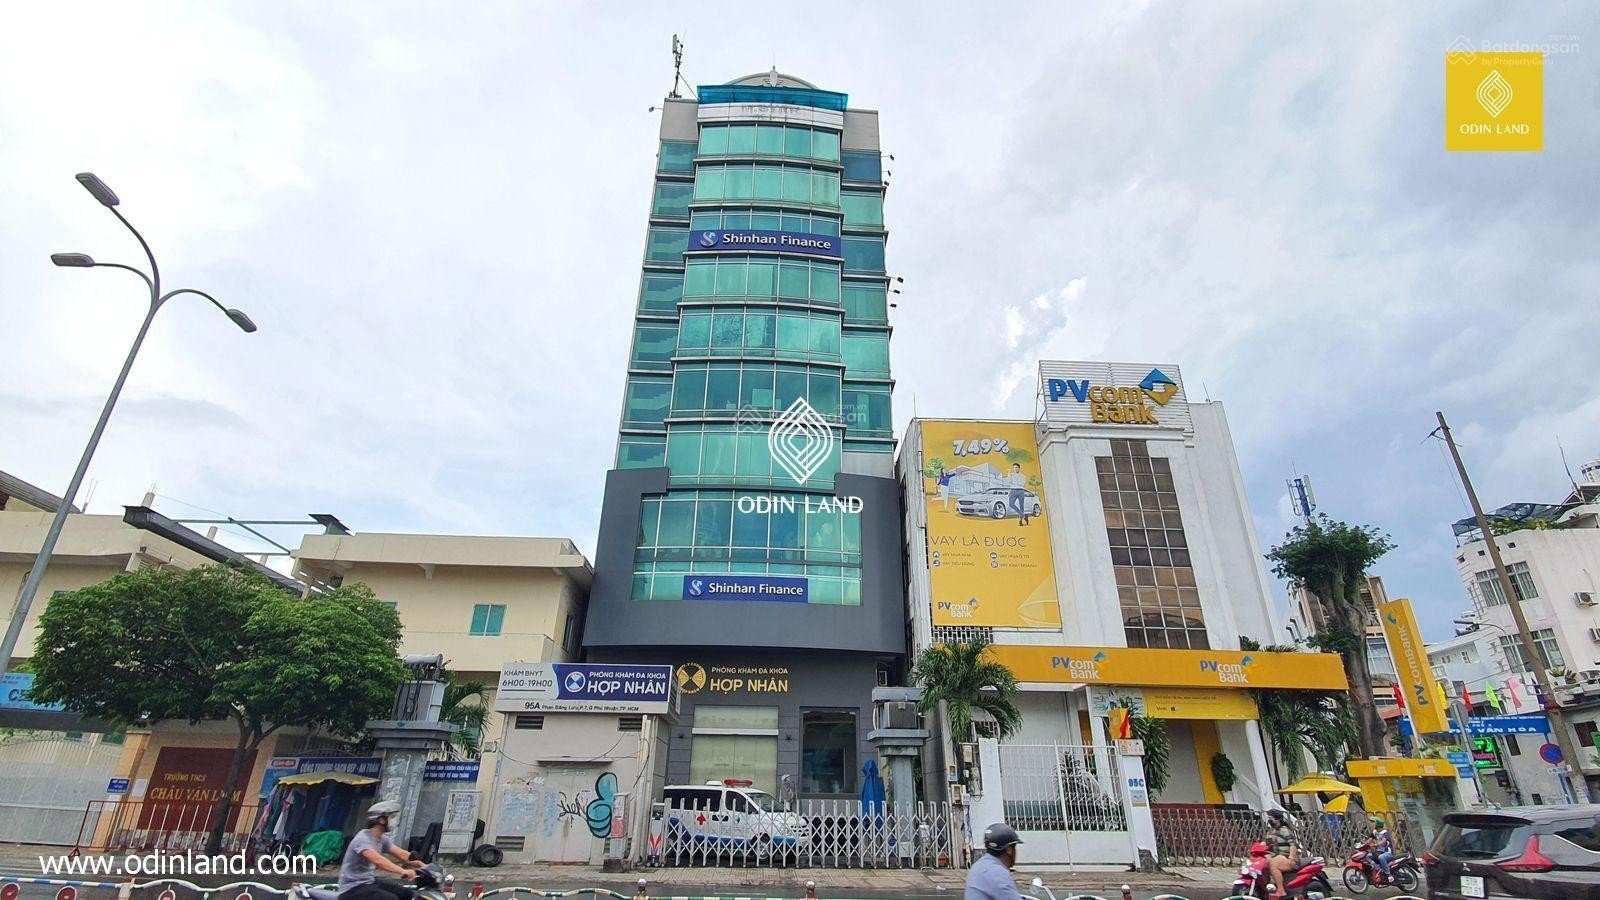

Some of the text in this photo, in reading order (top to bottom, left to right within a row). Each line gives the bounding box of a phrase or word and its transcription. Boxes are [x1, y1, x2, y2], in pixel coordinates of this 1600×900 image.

[722, 233, 832, 249] Shinhan Finance
[1048, 378, 1144, 405] PVcom
[1090, 402, 1159, 424] Bank
[953, 438, 1010, 457] 7,49%
[930, 535, 1027, 548] VAY LÀ ĐƯỢC
[708, 582, 804, 595] Shinhan Finance
[938, 601, 969, 610] PVcom
[951, 610, 973, 618] Bank
[711, 665, 736, 674] PHÒNG
[1052, 656, 1095, 670] PVcom
[1200, 660, 1242, 673] PVcom
[589, 671, 614, 679] PHÒNG
[1070, 669, 1101, 680] Bank
[1219, 672, 1249, 683] Bank
[587, 680, 666, 696] HỢP NHÂN
[710, 678, 788, 695] HỢP NHÂN
[524, 702, 541, 710] 95A
[1128, 778, 1144, 787] 95C
[151, 785, 183, 800] CHÂU
